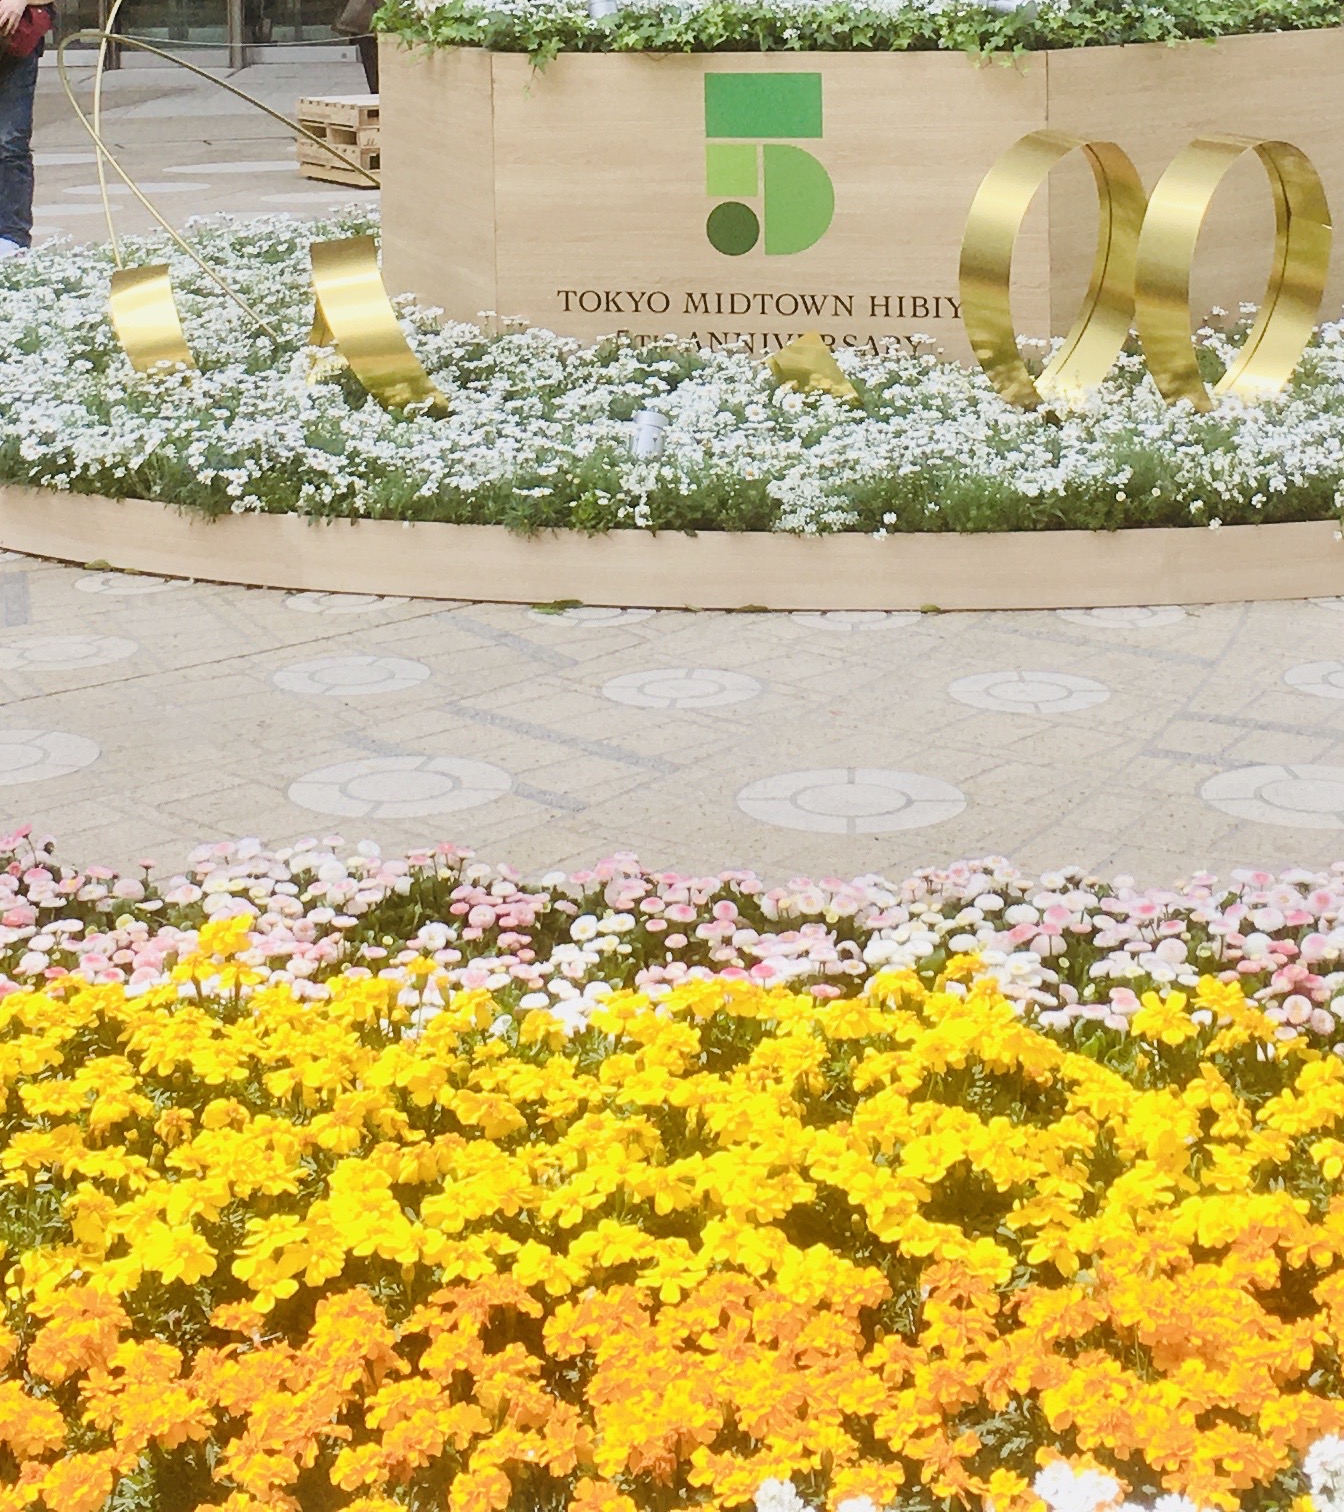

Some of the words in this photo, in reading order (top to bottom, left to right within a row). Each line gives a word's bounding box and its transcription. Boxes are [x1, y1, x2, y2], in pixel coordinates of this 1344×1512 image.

[557, 290, 670, 314] TOKYO
[683, 292, 855, 317] MIDTOWN
[869, 295, 961, 319] HIBIY
